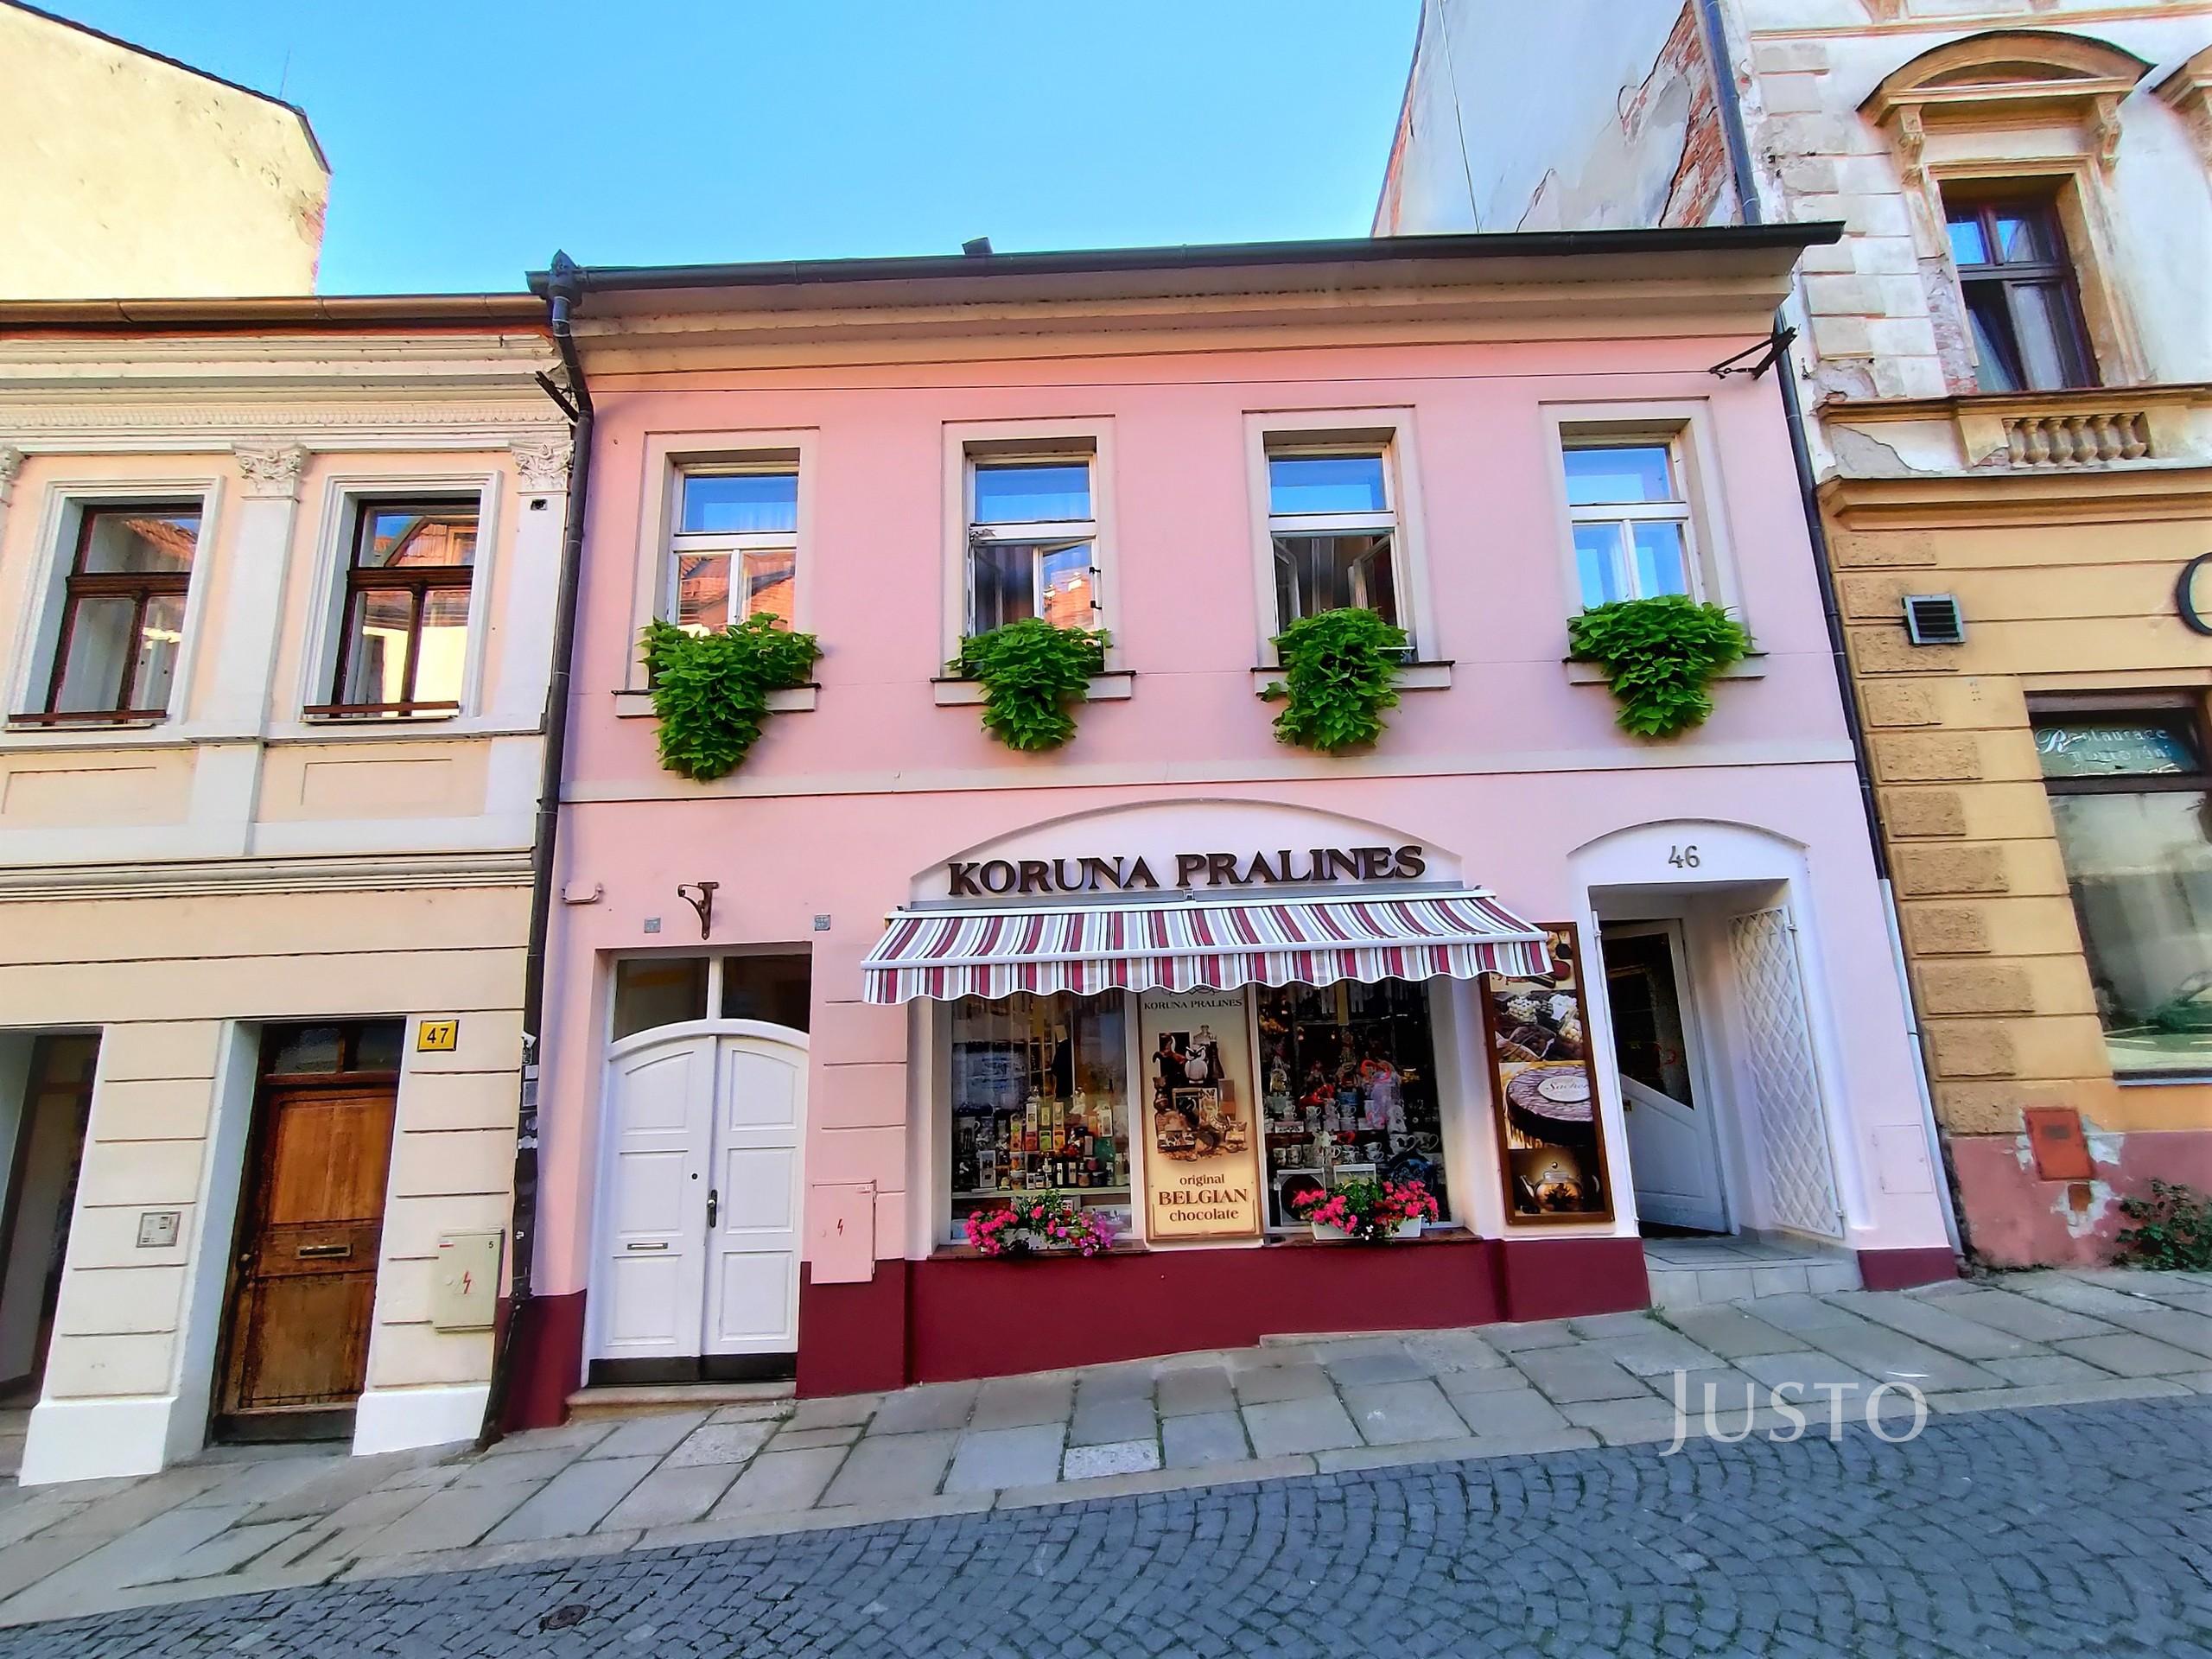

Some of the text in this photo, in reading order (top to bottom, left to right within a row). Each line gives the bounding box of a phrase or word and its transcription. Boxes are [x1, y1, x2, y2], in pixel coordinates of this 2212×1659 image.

[1668, 845, 1700, 868] 46
[948, 845, 1426, 895] KORUNA PRALINES
[1144, 999, 1243, 1010] KORUNA PRALINES
[427, 1027, 449, 1044] 47
[1179, 1174, 1225, 1187] original
[1159, 1188, 1247, 1205] BELGIAN
[1169, 1208, 1240, 1222] chocolate
